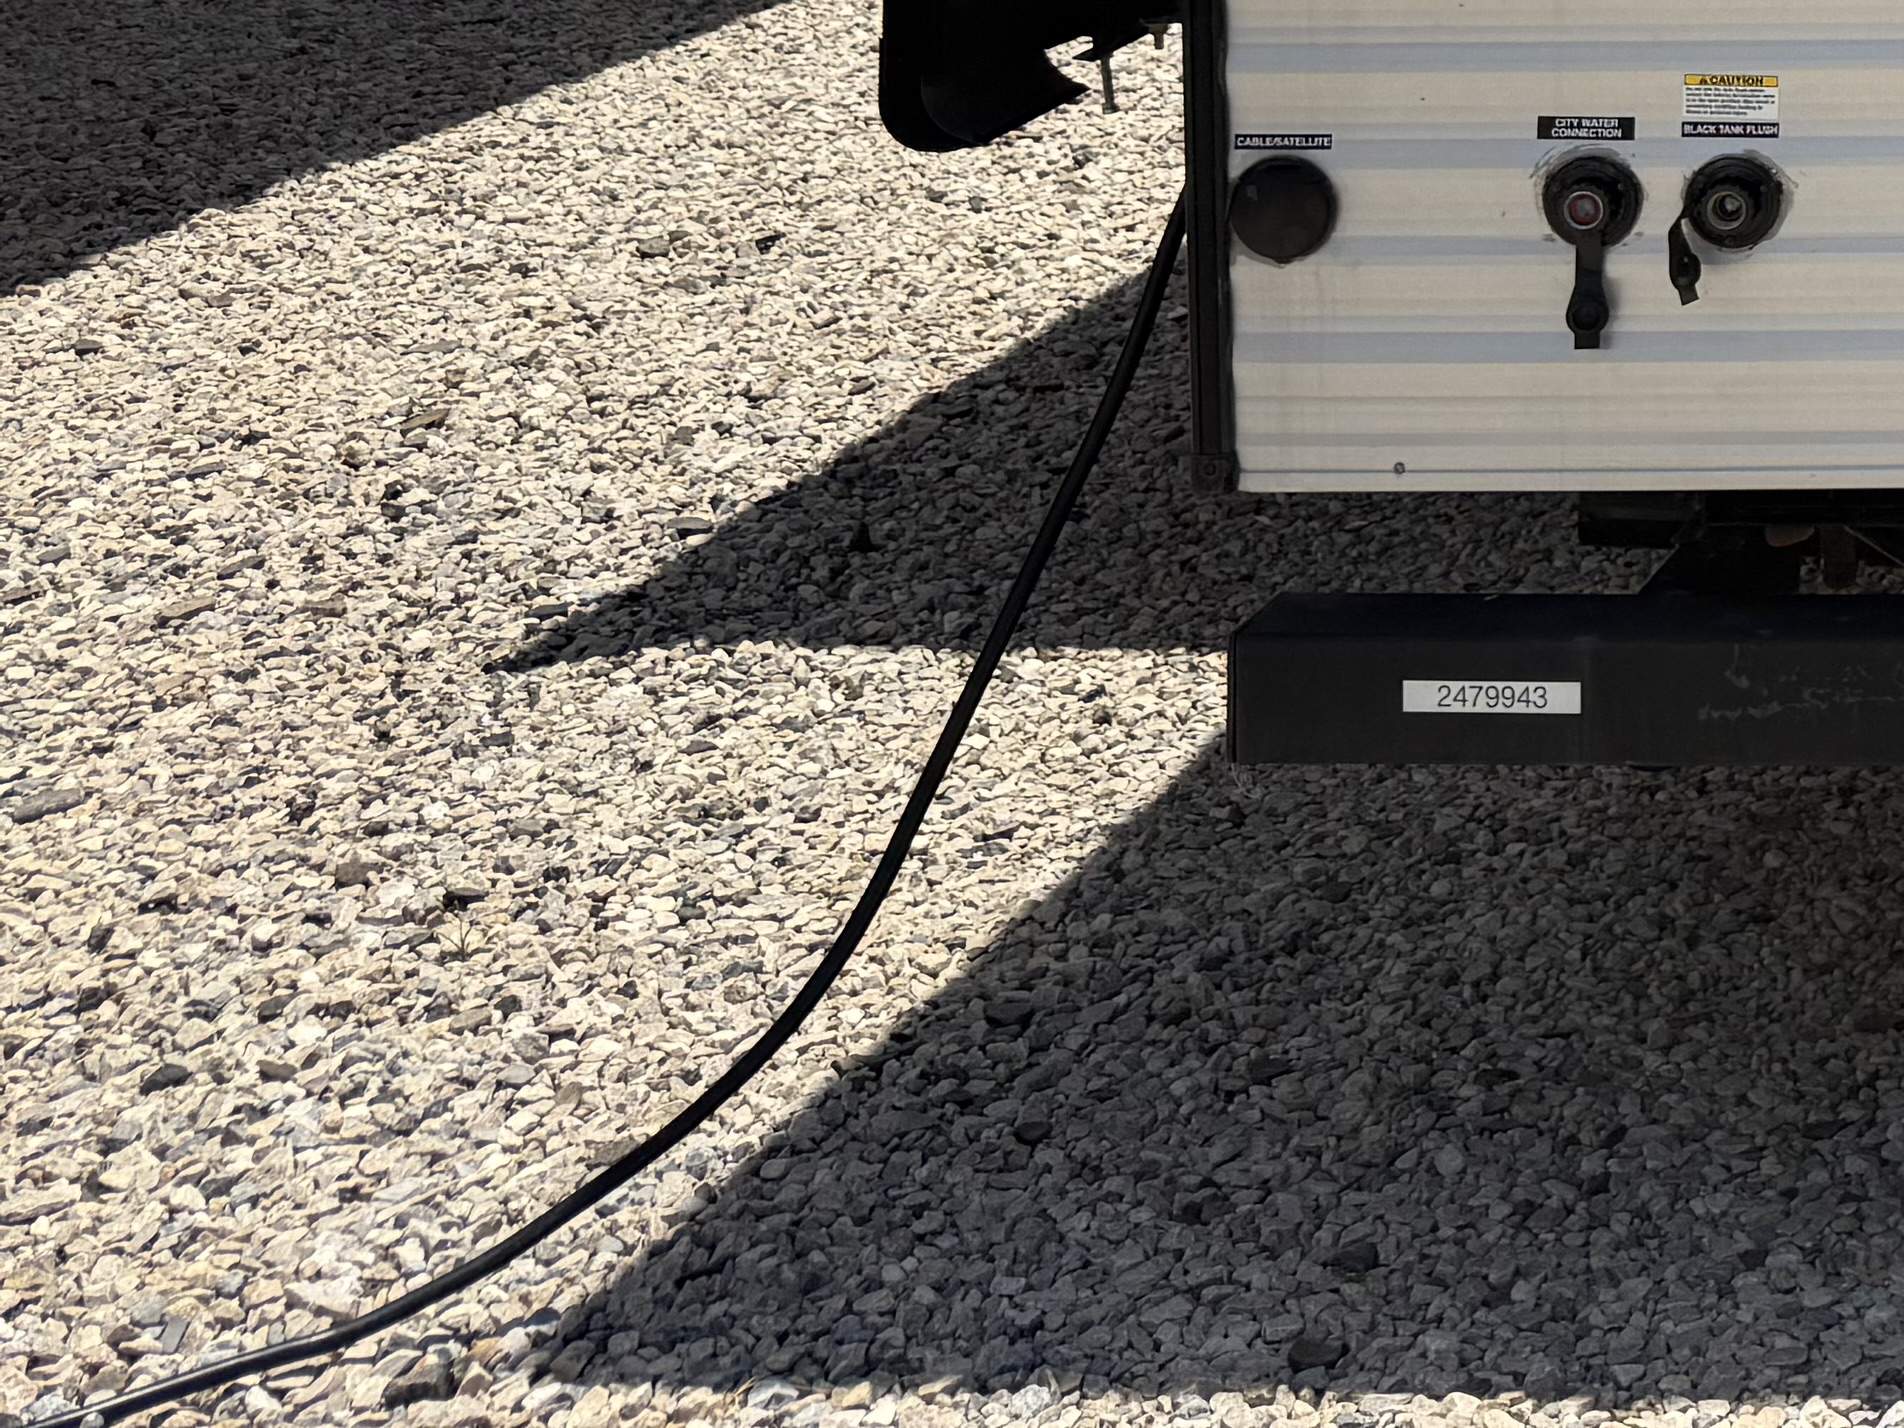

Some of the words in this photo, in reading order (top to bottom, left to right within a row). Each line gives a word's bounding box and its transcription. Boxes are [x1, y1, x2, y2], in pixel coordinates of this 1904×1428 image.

[1709, 75, 1764, 86] CAUTION
[1555, 118, 1579, 127] CITY
[1581, 118, 1619, 128] WATER
[1551, 127, 1622, 138] CONNECTION
[1683, 124, 1717, 134] BLACK
[1718, 124, 1745, 135] TANK
[1746, 125, 1778, 135] FLUSH
[1236, 137, 1331, 146] CABLE/SATELLITE
[1437, 684, 1549, 709] 2479943
